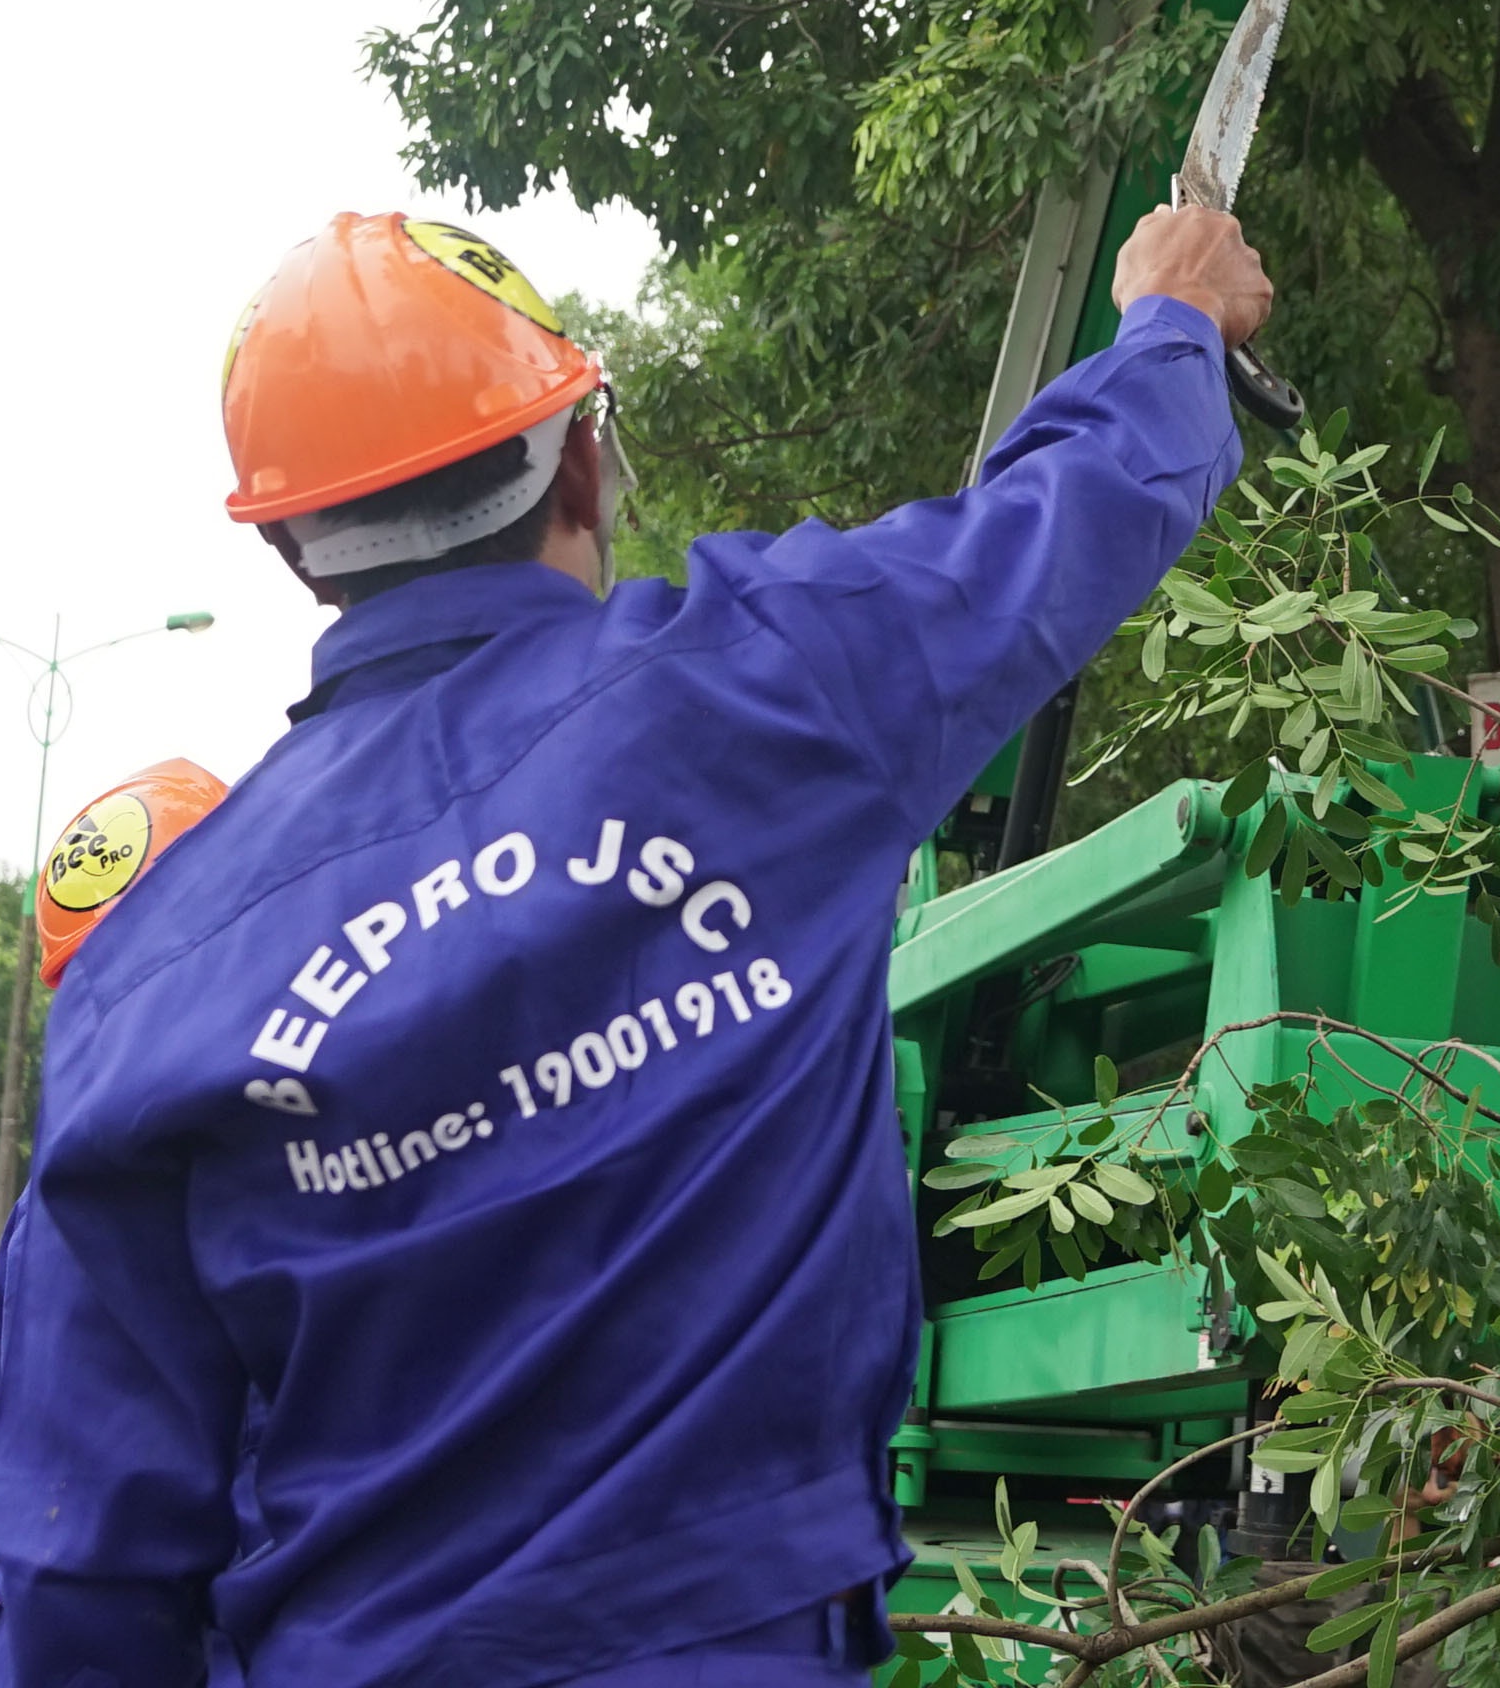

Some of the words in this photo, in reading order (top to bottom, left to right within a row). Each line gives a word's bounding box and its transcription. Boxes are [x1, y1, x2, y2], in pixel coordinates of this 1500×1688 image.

[100, 844, 133, 869] PRO
[245, 831, 536, 1115] BEEPRO
[567, 818, 752, 953] JSC
[286, 1101, 494, 1193] Hotline:
[500, 958, 793, 1119] 19001918
